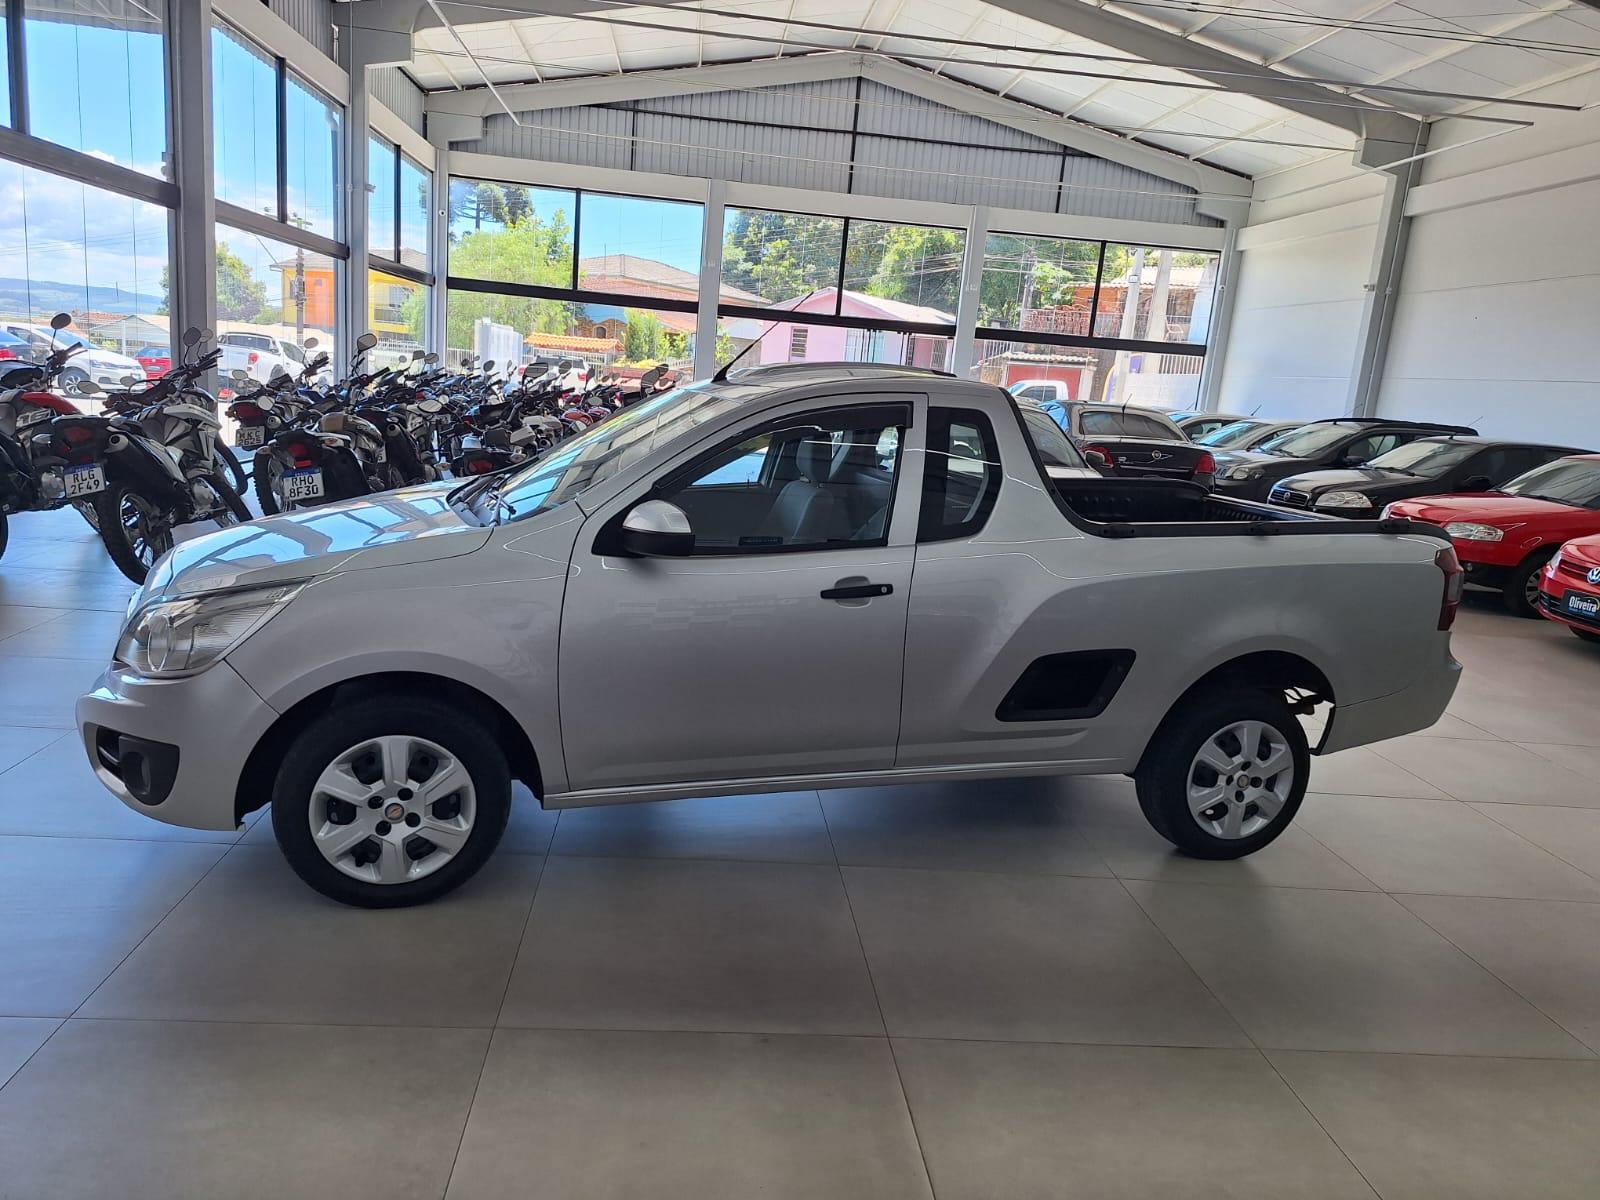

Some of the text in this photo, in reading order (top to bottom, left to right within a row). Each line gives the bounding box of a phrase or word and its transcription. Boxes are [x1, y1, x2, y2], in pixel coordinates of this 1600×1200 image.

[73, 469, 95, 482] RLG
[70, 480, 100, 494] 2F49
[289, 484, 319, 498] 8F30
[1569, 596, 1597, 612] Oliveira
